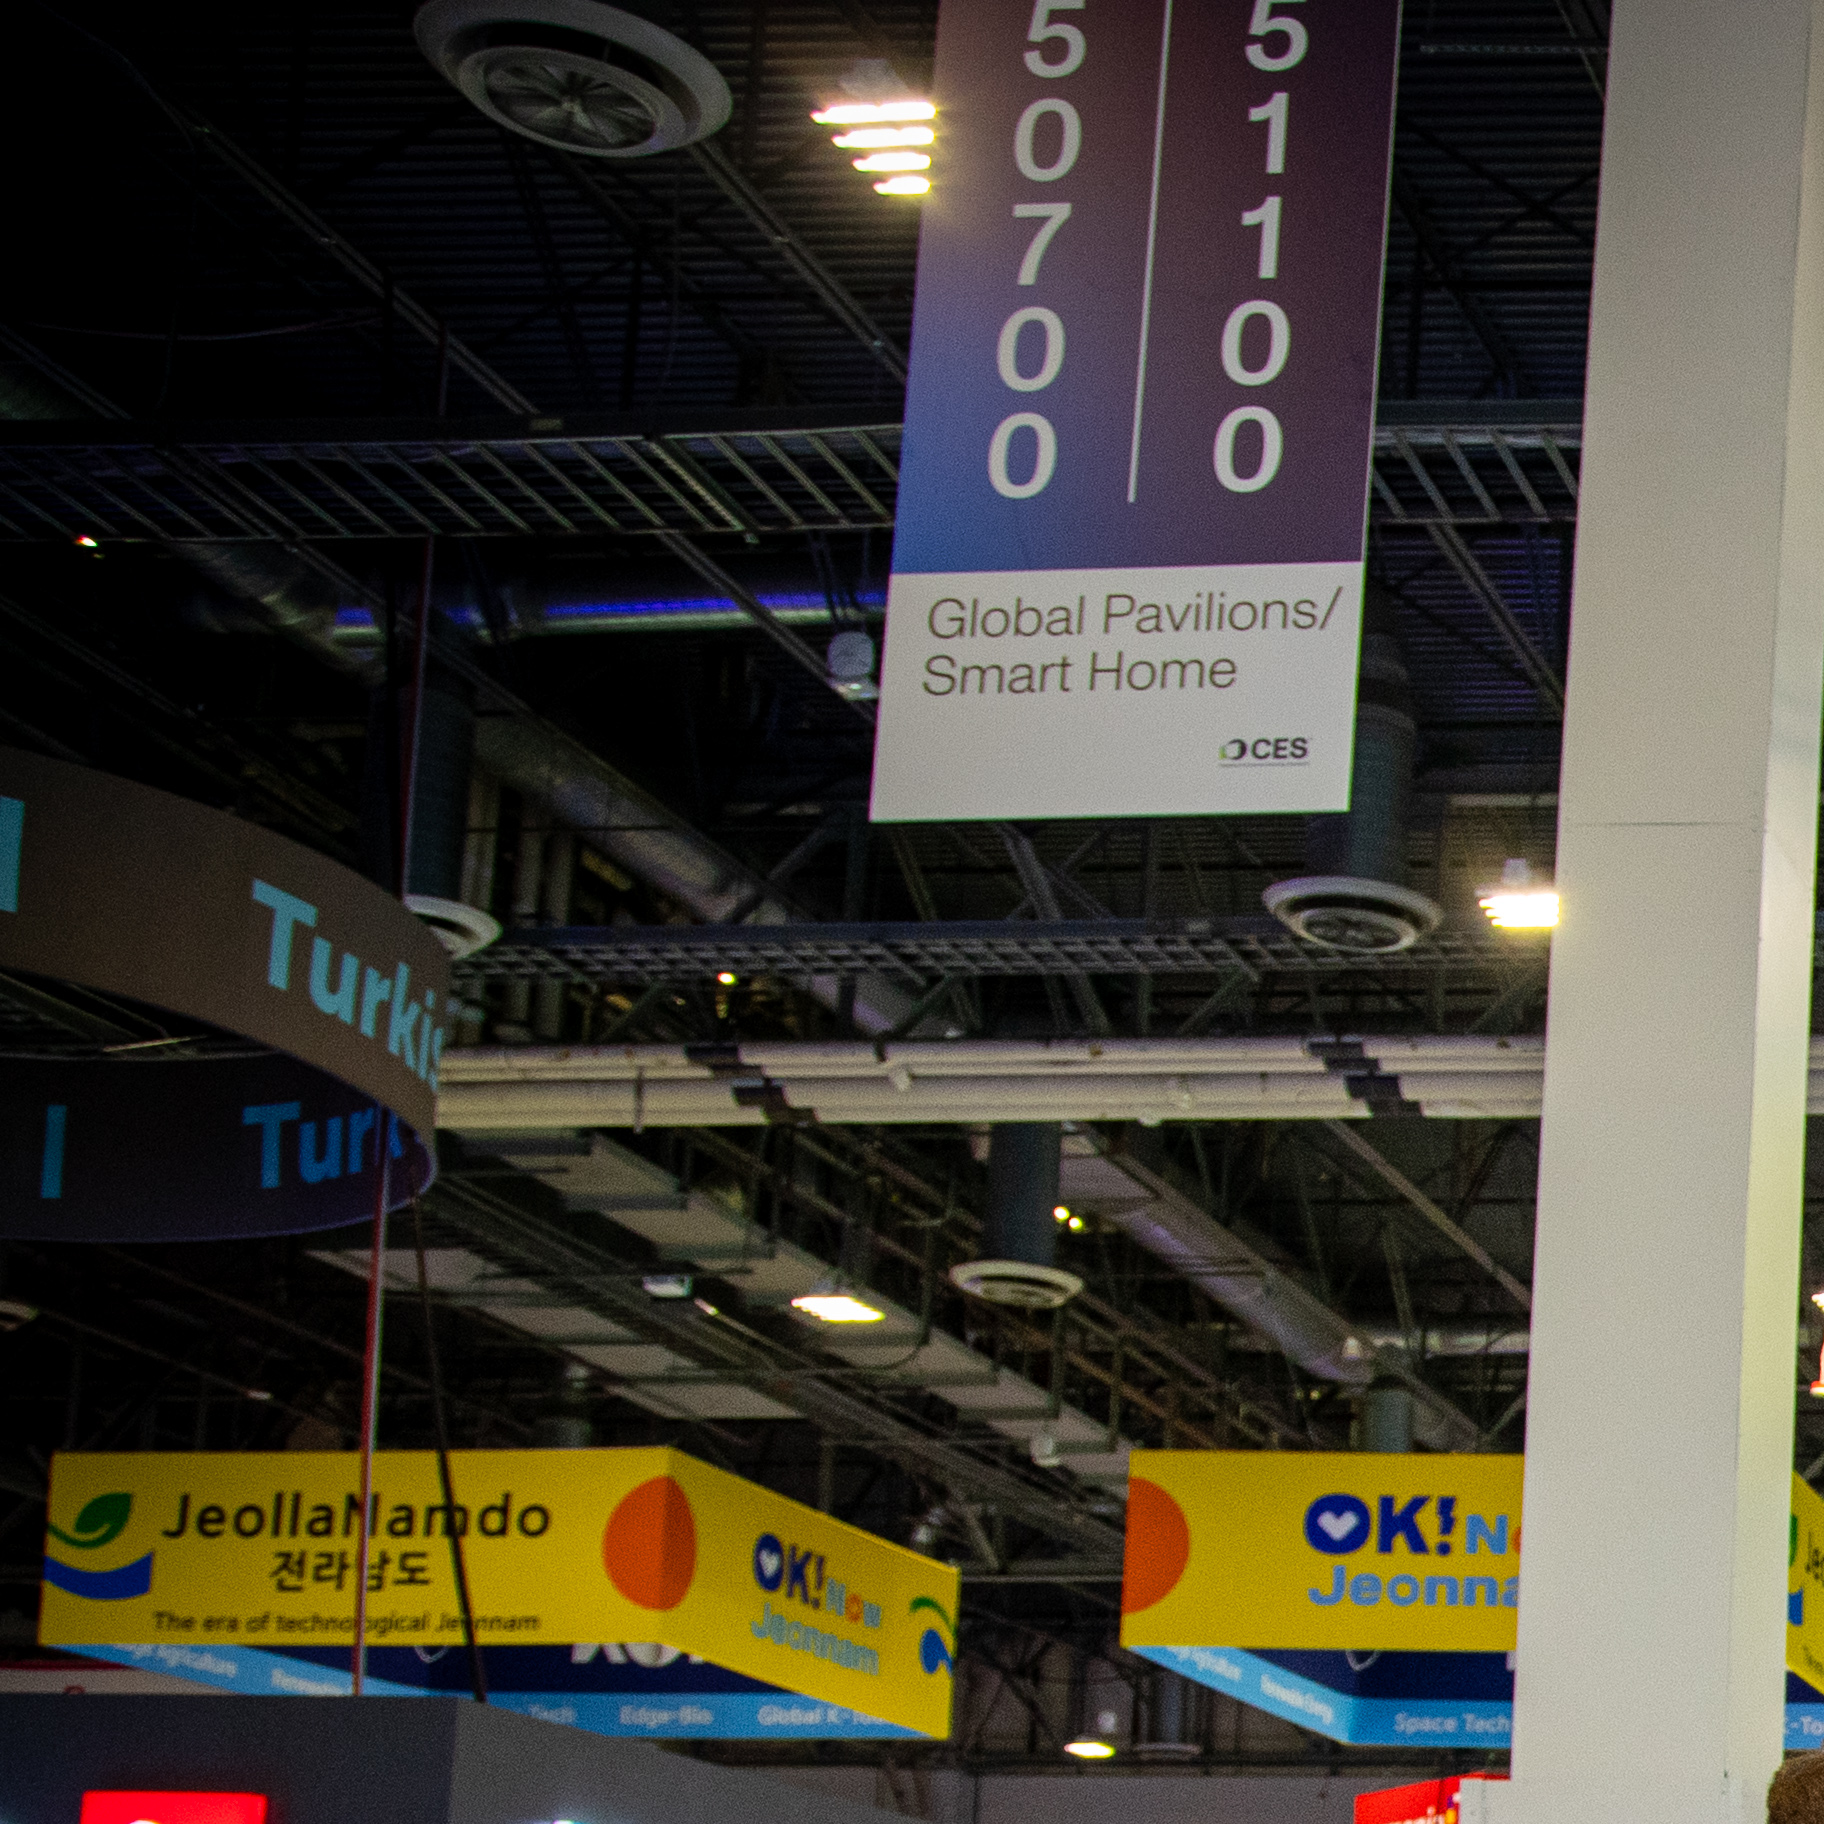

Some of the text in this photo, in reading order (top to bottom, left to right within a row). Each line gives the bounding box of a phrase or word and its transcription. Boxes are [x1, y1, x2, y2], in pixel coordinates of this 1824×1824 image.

[987, 0, 1088, 499] 50700
[1213, 0, 1310, 493] 51100
[927, 584, 1344, 640] Global Pavilions/
[921, 650, 1238, 697] Smart Home
[1250, 737, 1309, 760] CES
[152, 1610, 195, 1633] The
[203, 1614, 239, 1633] era
[245, 1611, 271, 1634] of
